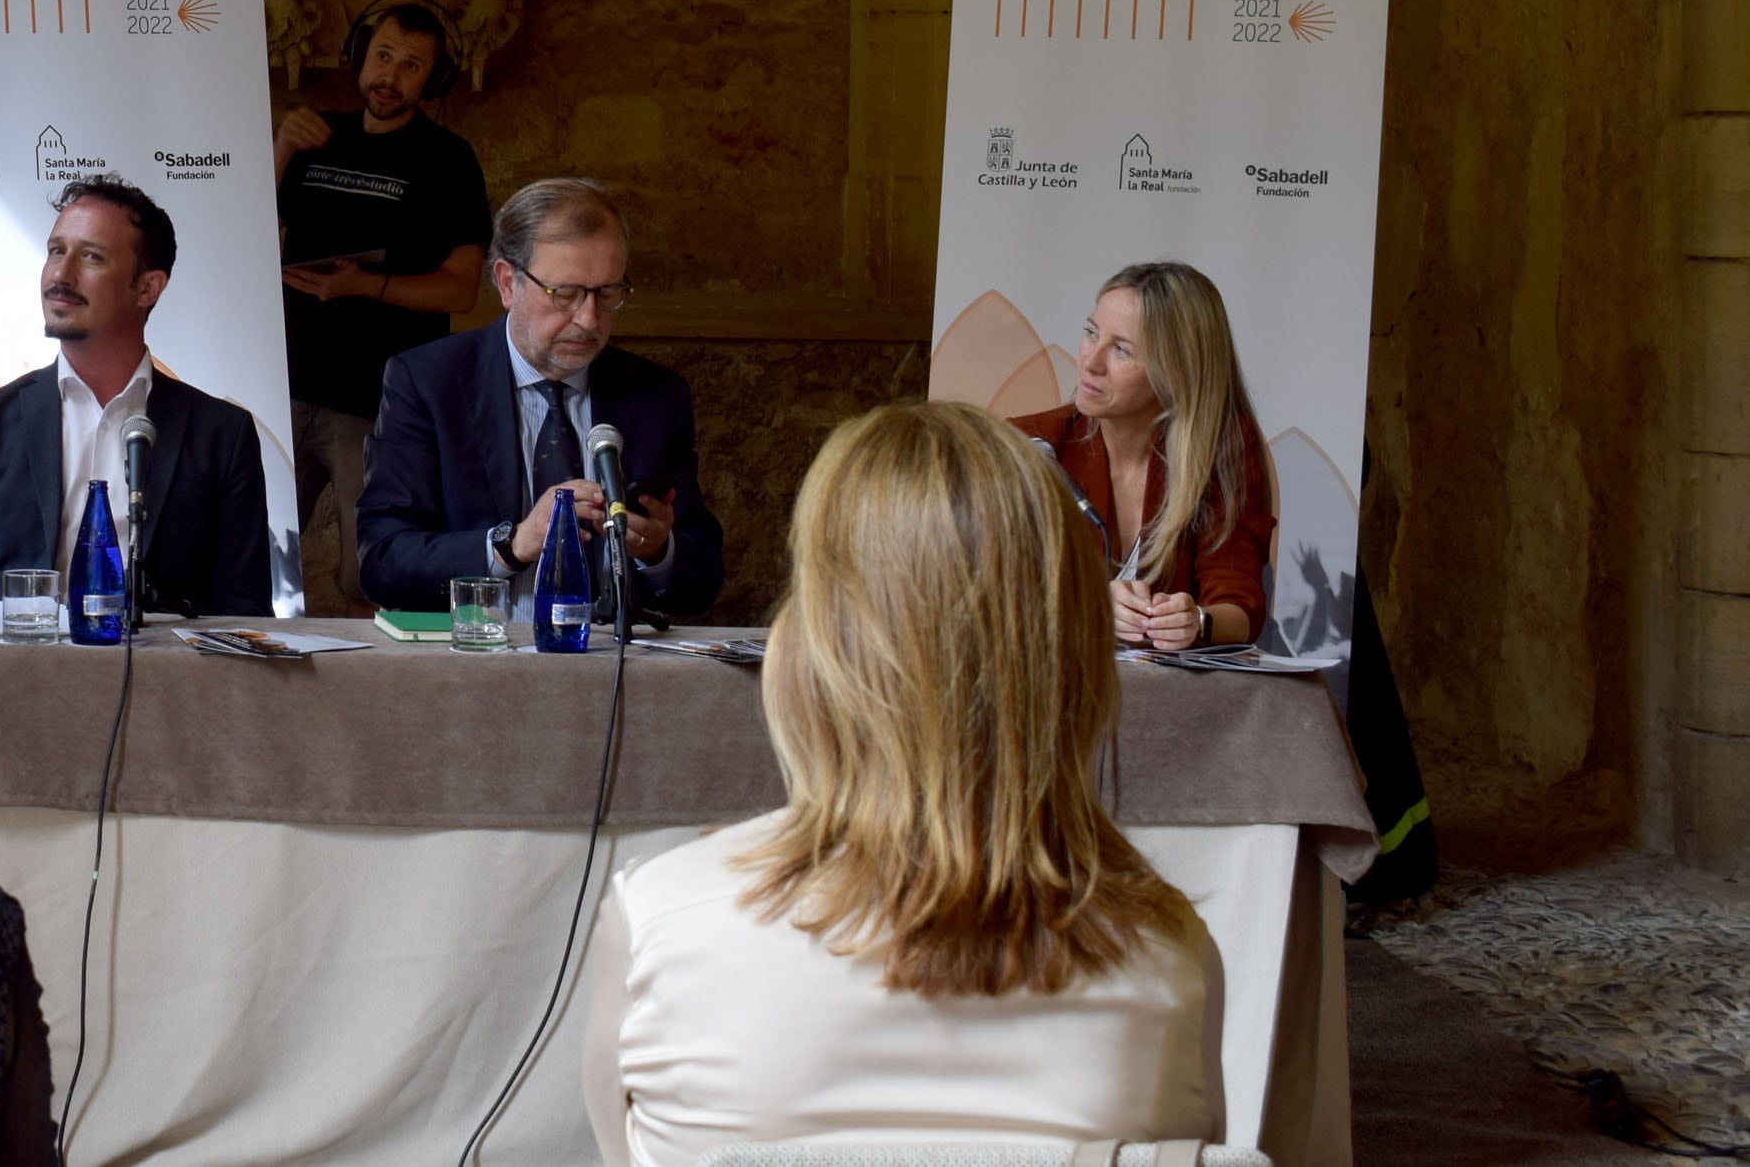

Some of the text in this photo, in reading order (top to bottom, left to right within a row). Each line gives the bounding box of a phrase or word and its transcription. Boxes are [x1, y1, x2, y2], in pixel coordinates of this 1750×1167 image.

[127, 16, 173, 35] 2022
[1232, 23, 1282, 43] 2022
[45, 157, 106, 168] Santa María
[165, 153, 230, 167] Sabadell
[1015, 160, 1078, 174] Junta de
[1128, 167, 1193, 180] Santa María
[46, 171, 81, 181] la Real
[166, 170, 215, 180] Fundación
[1256, 167, 1328, 185] Sabadell
[978, 174, 1077, 190] Castilla y León
[1128, 180, 1138, 191] la
[1141, 180, 1164, 192] Real
[1256, 186, 1310, 198] Fundación
